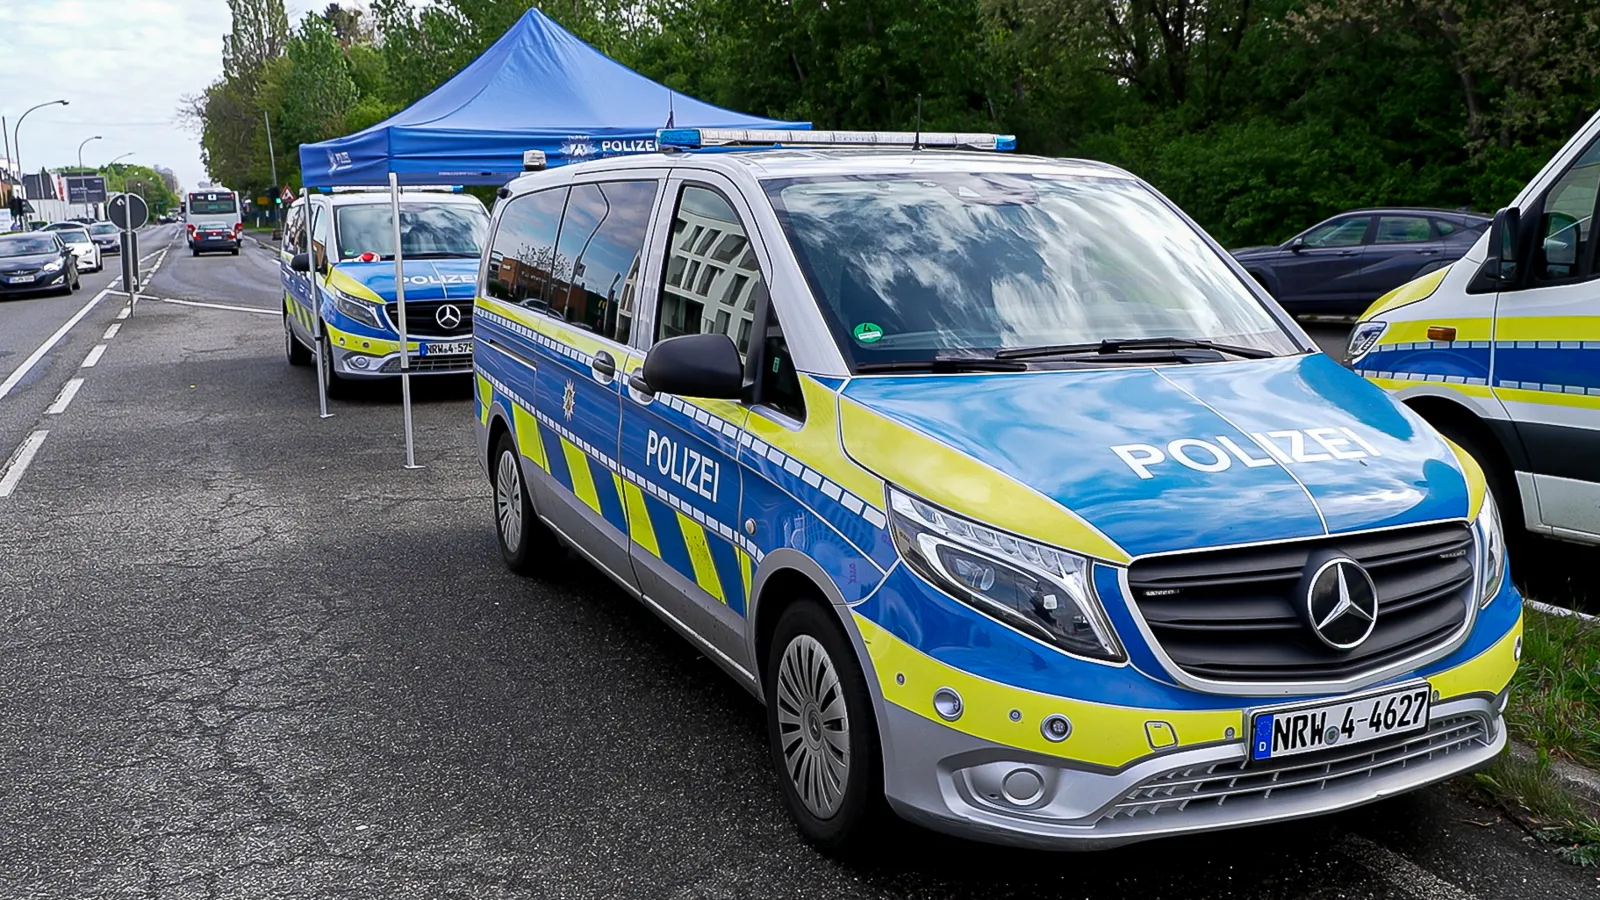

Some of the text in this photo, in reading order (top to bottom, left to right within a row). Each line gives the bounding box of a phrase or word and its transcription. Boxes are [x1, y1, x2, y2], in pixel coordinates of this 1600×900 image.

[601, 140, 659, 152] POLIZEI
[863, 323, 872, 332] 4
[425, 344, 444, 354] NRW
[1109, 426, 1382, 480] POLIZEI
[646, 429, 719, 503] POLIZEI
[1272, 691, 1428, 752] NRW 4-4627
[1259, 742, 1267, 752] D
